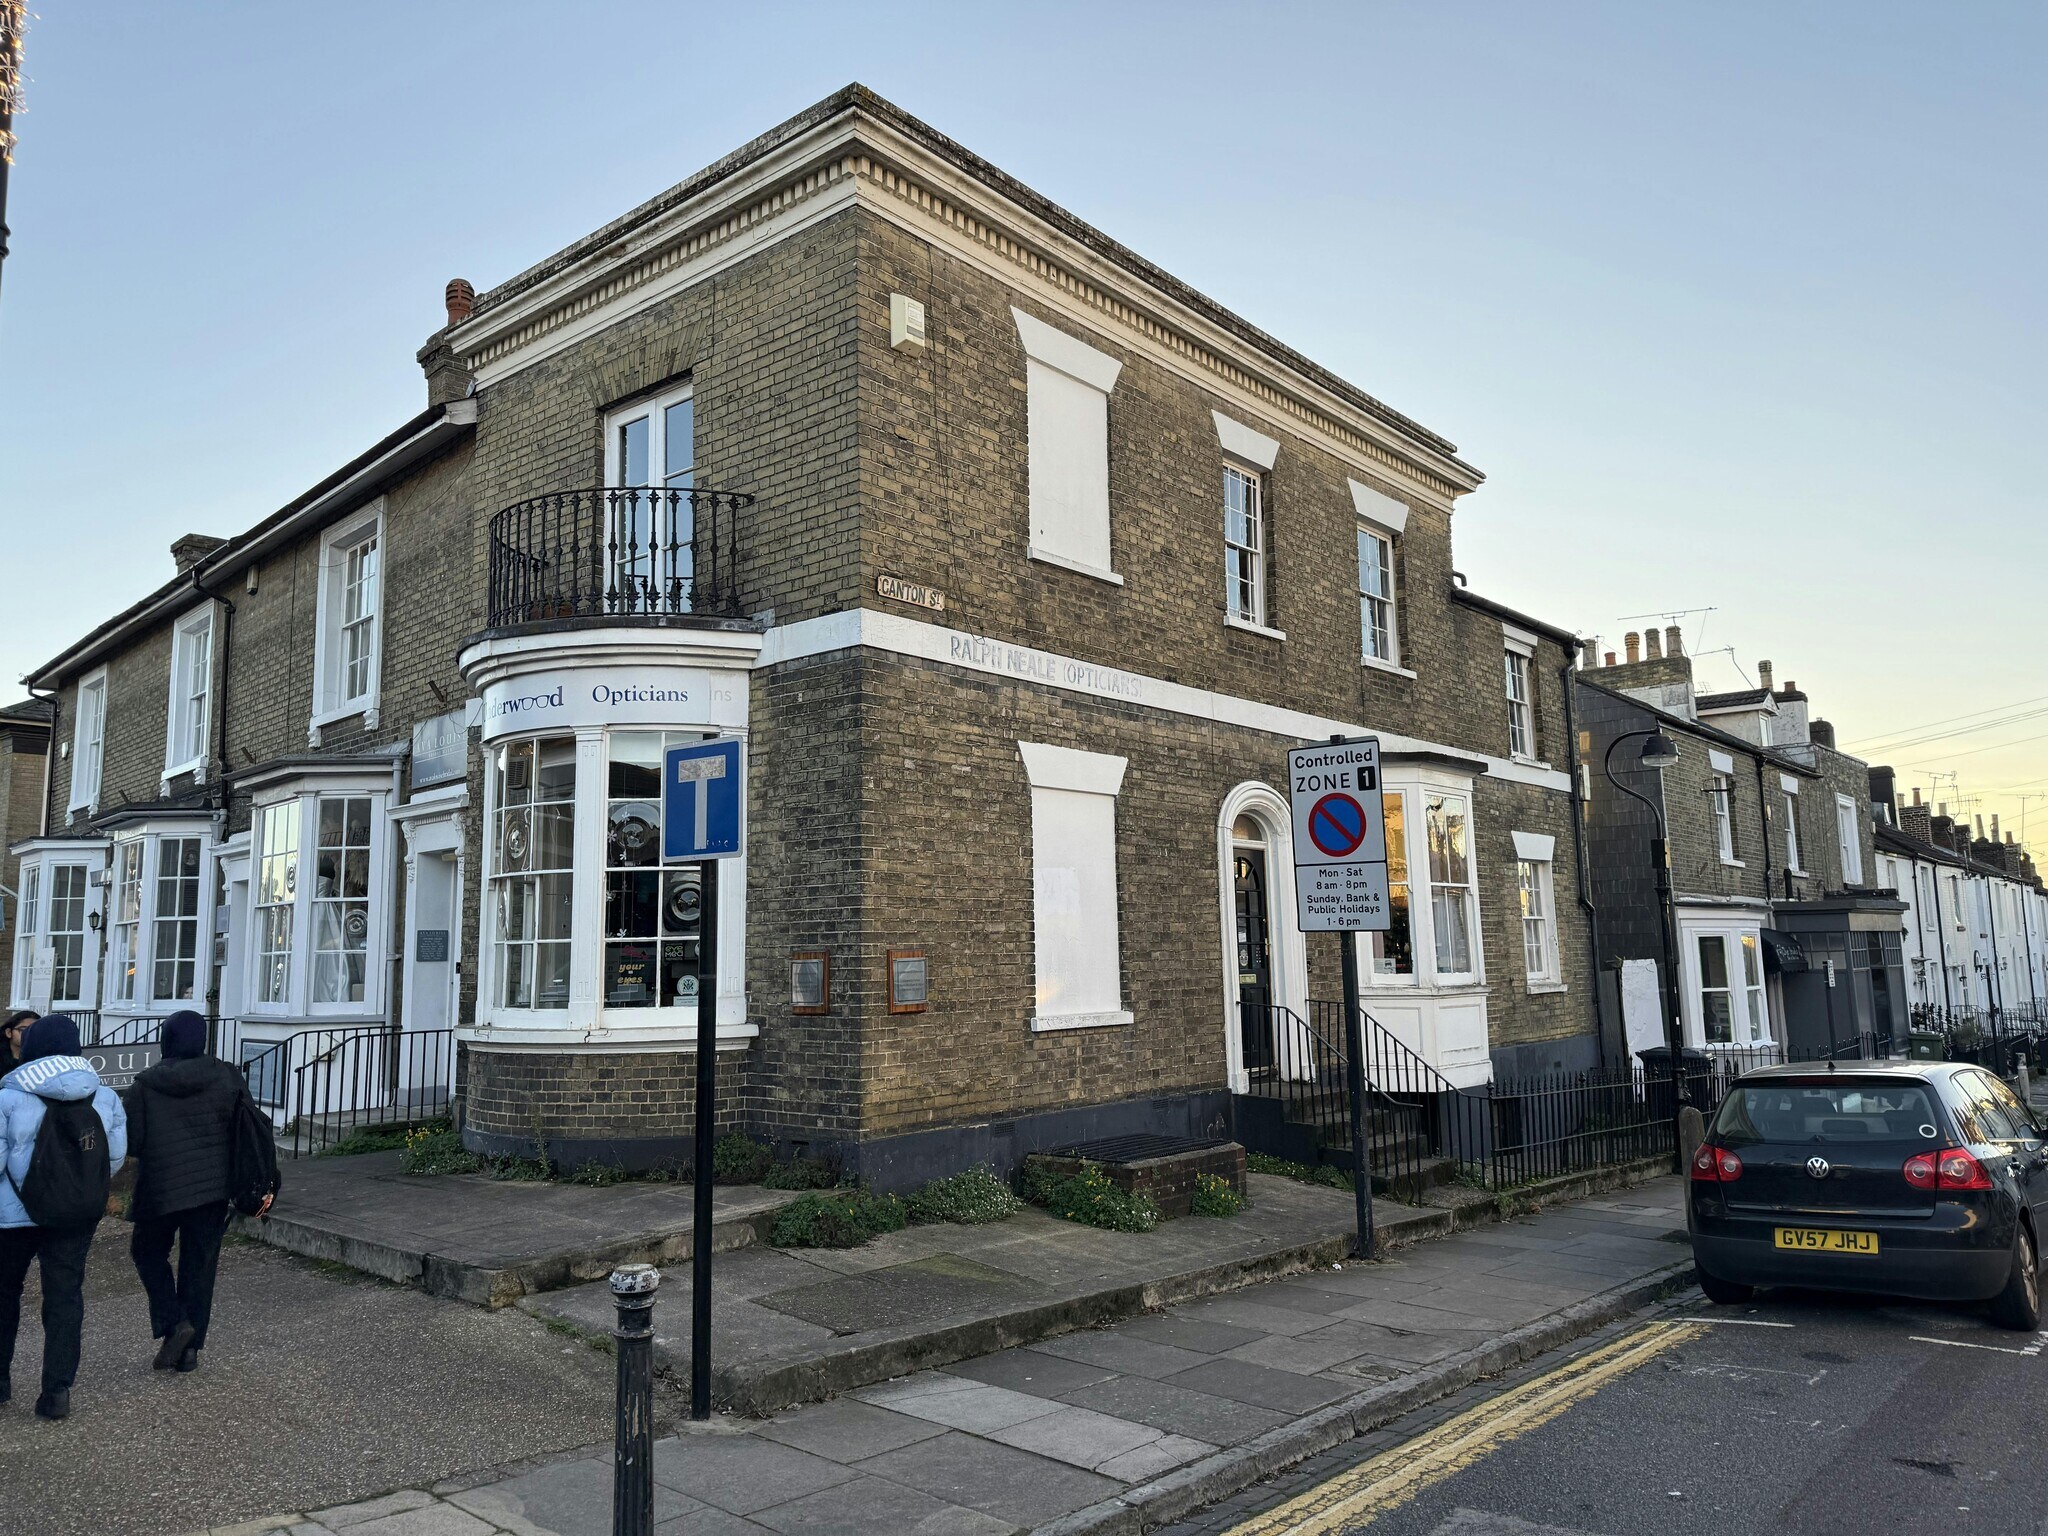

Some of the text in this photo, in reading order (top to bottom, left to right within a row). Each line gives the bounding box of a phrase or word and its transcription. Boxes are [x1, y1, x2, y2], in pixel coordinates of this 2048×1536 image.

[882, 578, 926, 605] CANTON
[950, 635, 1143, 699] RALPH NEALE (OPTICIANS)
[592, 685, 688, 705] Opticians
[1295, 748, 1372, 769] Controlled
[1296, 770, 1370, 792] ZONE 1
[1319, 869, 1339, 878] Mon
[1346, 868, 1363, 877] Sat
[1346, 894, 1370, 903] Bank
[1373, 893, 1380, 902] &
[1308, 905, 1380, 914] Public Holidays
[618, 963, 645, 973] your
[617, 976, 643, 985] eyes
[1783, 1230, 1870, 1250] GV57 JHJ
